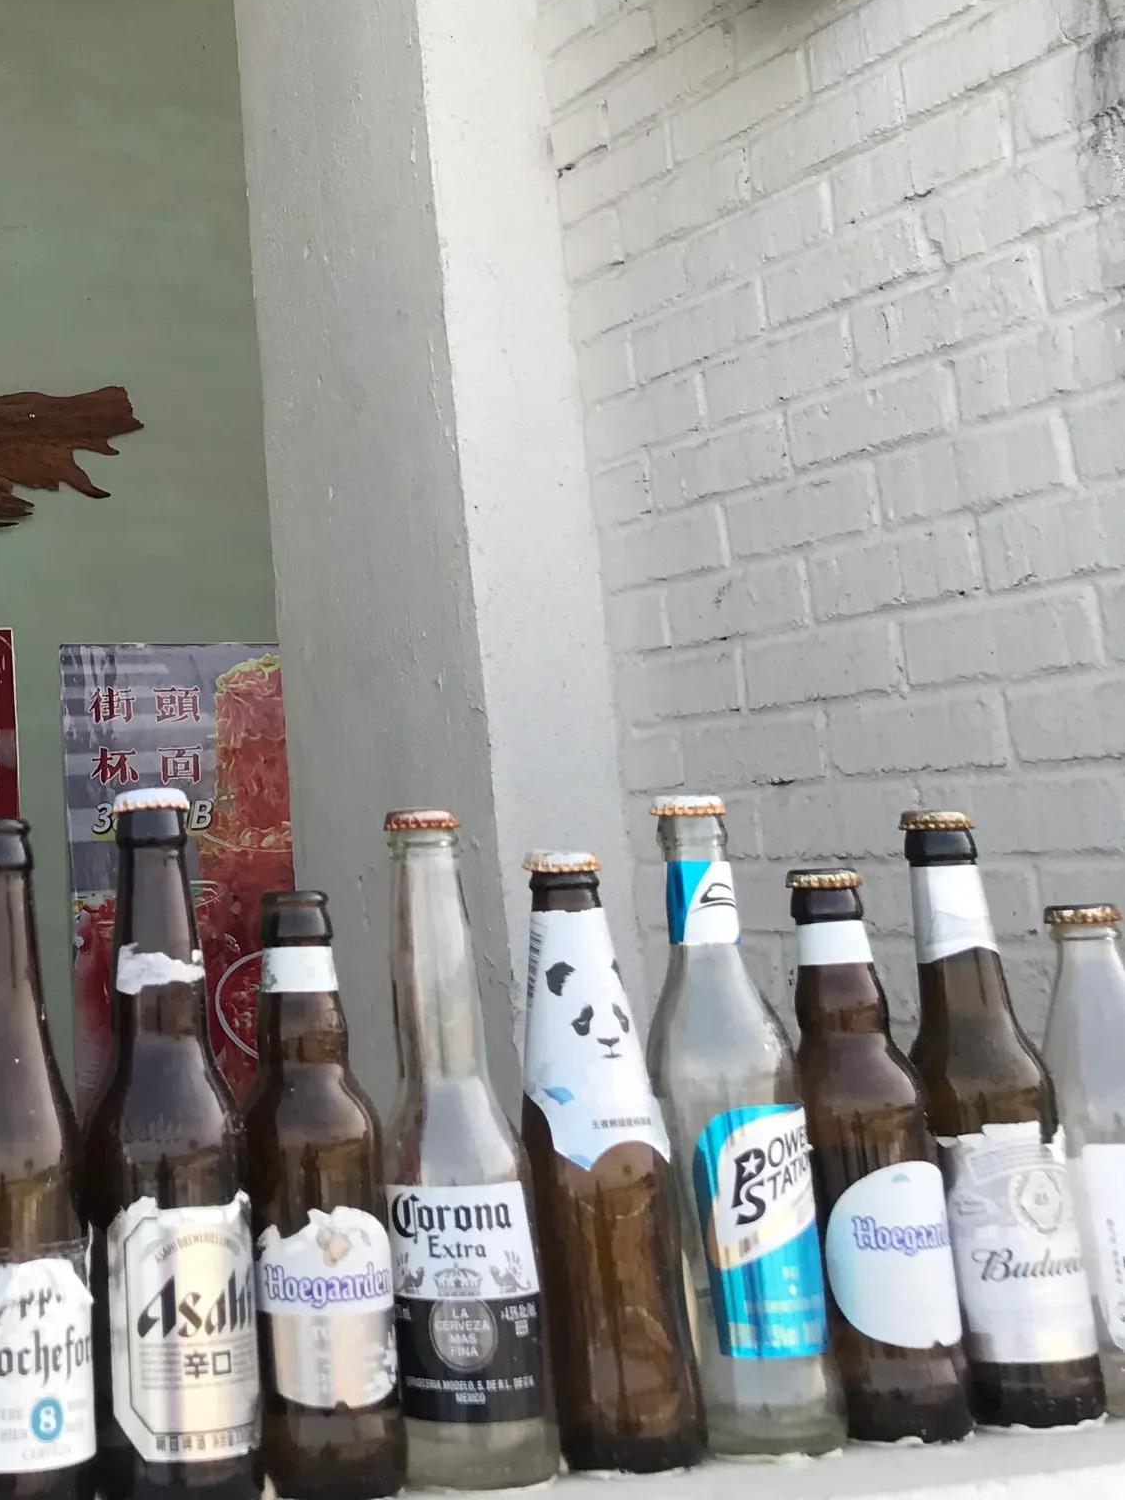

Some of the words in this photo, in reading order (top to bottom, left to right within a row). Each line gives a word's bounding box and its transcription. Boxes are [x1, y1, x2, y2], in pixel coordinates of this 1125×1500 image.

[391, 1192, 513, 1244] Corona
[427, 1234, 487, 1260] Extra
[264, 1262, 390, 1309] Hoegaarden
[435, 1319, 491, 1332] CERVEZA
[451, 1308, 470, 1319] LA
[184, 1349, 233, 1380] 辛口
[449, 1345, 479, 1357] FINA
[40, 1405, 57, 1434] 8
